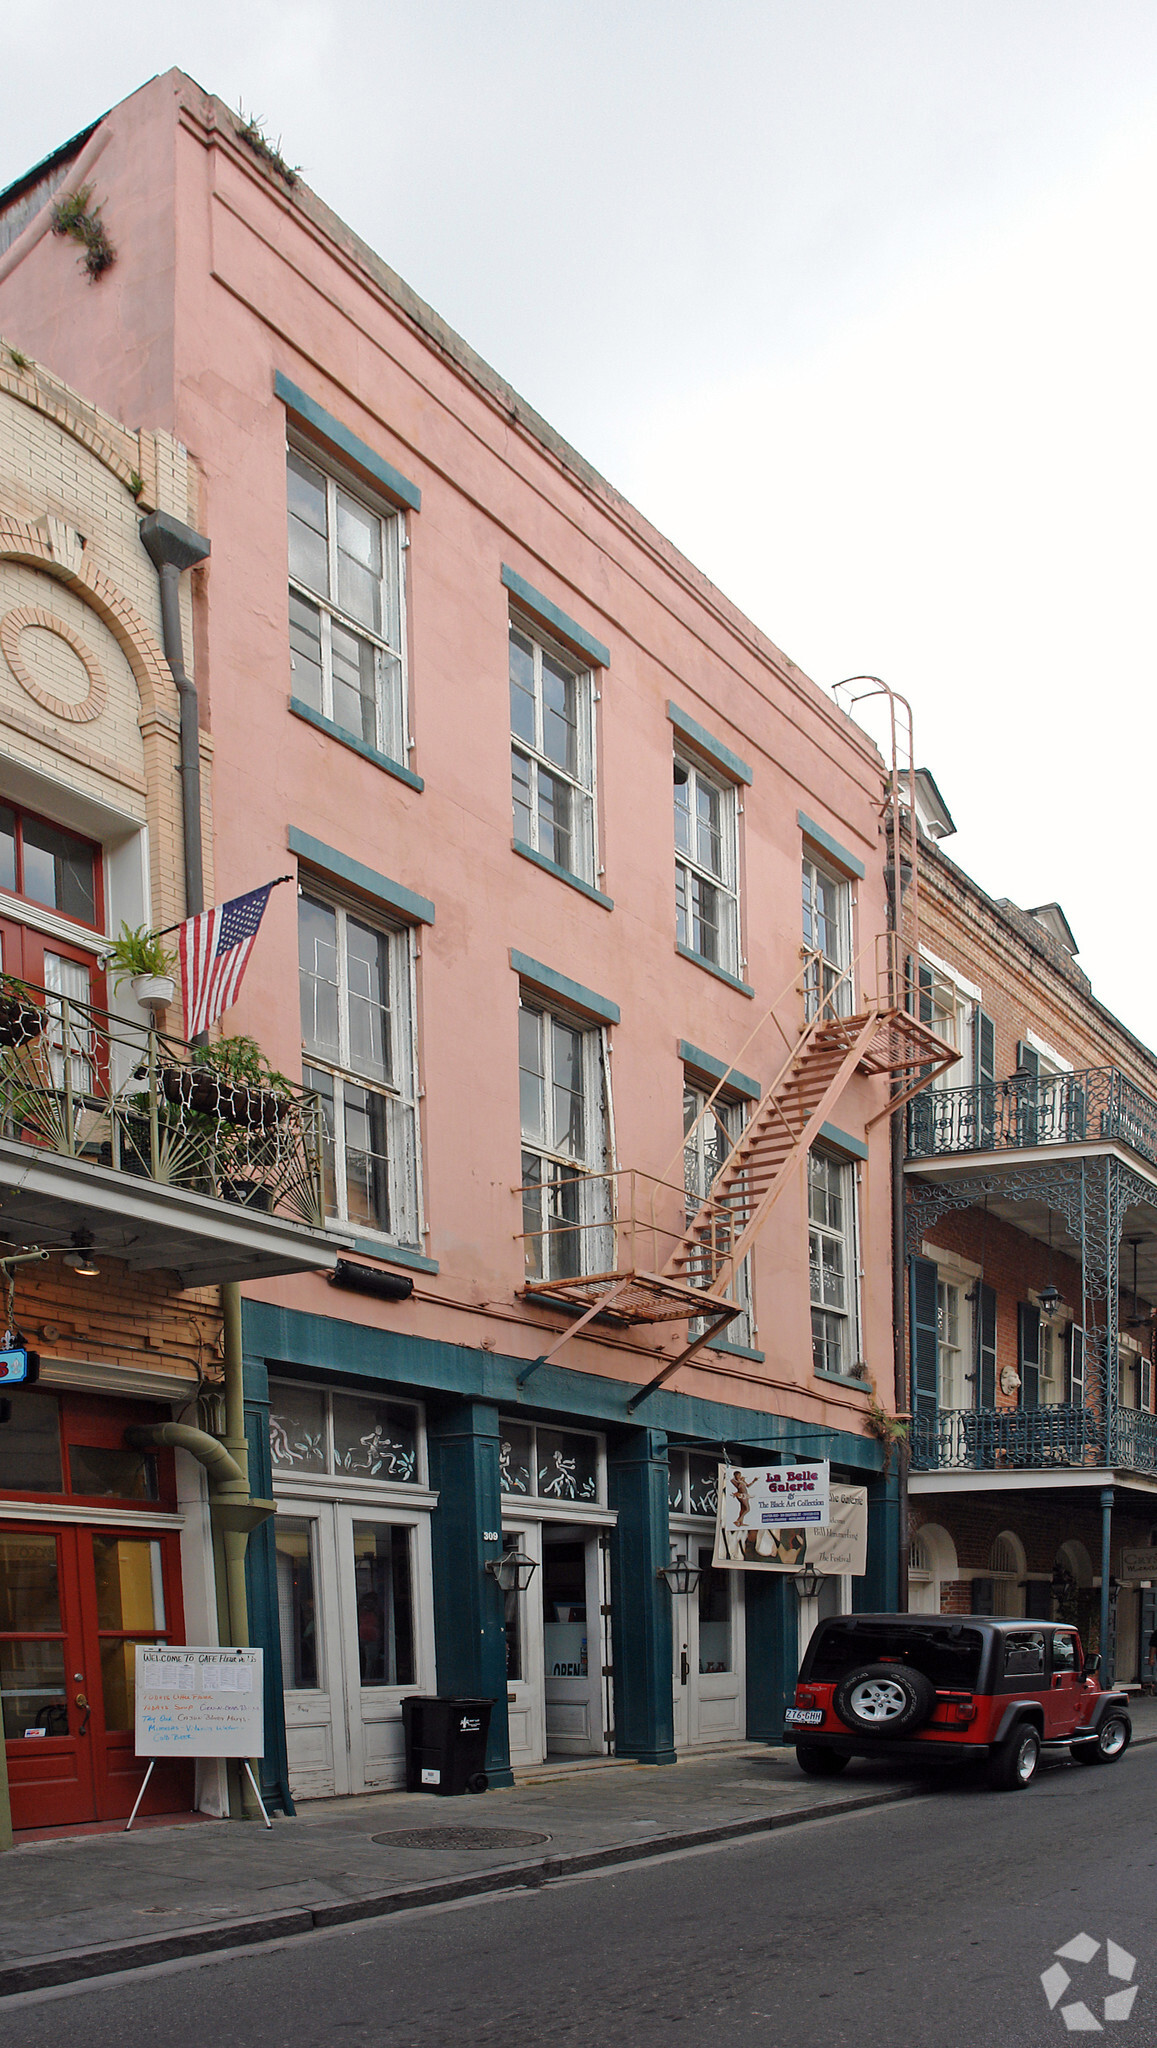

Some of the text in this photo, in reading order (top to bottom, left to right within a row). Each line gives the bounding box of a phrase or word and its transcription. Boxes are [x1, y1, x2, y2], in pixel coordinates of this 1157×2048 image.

[766, 1471, 818, 1483] La Belle
[769, 1482, 815, 1493] Galerie
[758, 1501, 769, 1509] The
[770, 1500, 784, 1508] Black
[483, 1531, 499, 1541] 309
[813, 1527, 826, 1537] Bill
[819, 1551, 852, 1563] The Festival
[143, 1653, 182, 1663] WELCOME
[184, 1654, 194, 1662] TO
[198, 1654, 218, 1663] CAFE
[553, 1663, 581, 1676] OPEN
